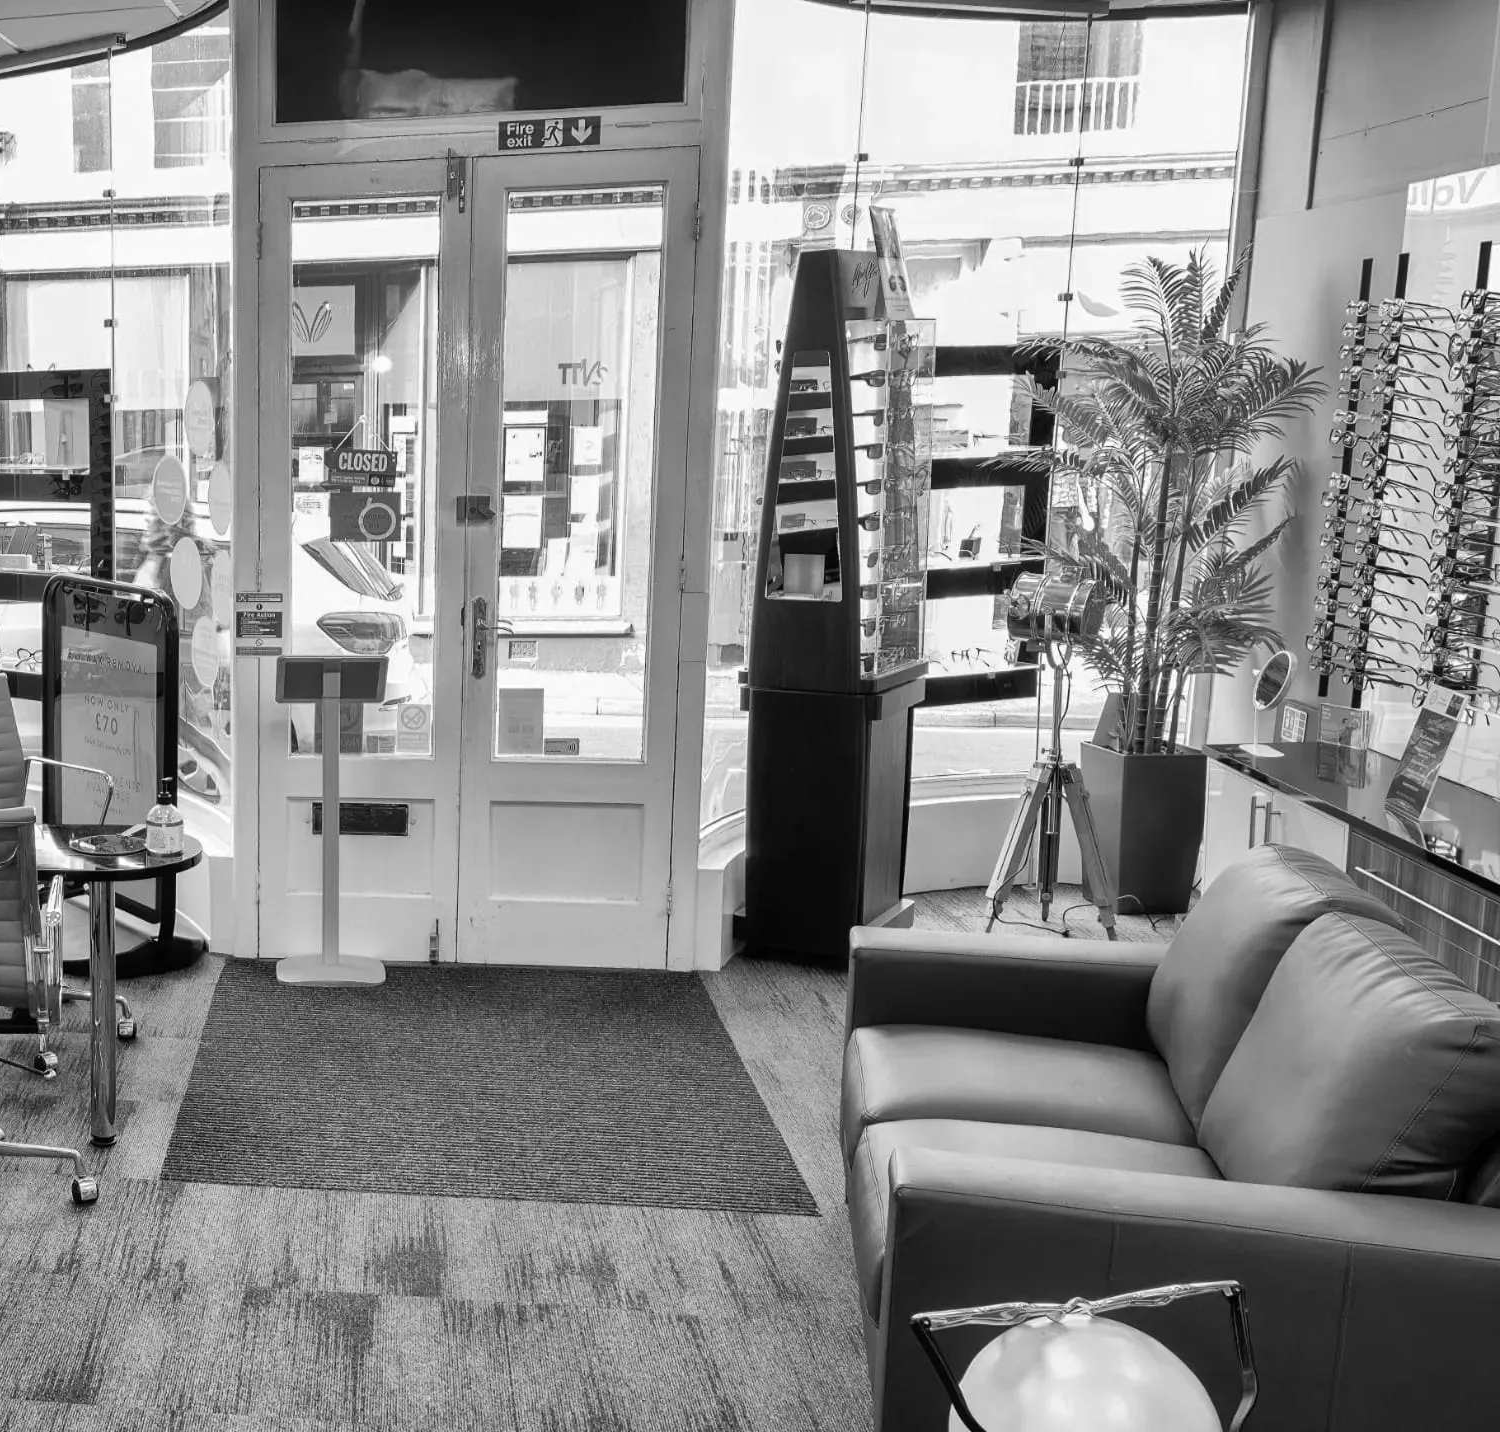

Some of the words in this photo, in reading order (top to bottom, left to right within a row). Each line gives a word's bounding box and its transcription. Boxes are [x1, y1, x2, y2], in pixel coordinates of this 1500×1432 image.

[506, 122, 534, 135] Fire
[506, 134, 532, 148] exit
[338, 452, 388, 472] CLOSED
[106, 656, 148, 676] REMOVAL
[84, 695, 104, 707] NOW
[107, 699, 129, 713] ONLY
[95, 712, 118, 735] £70
